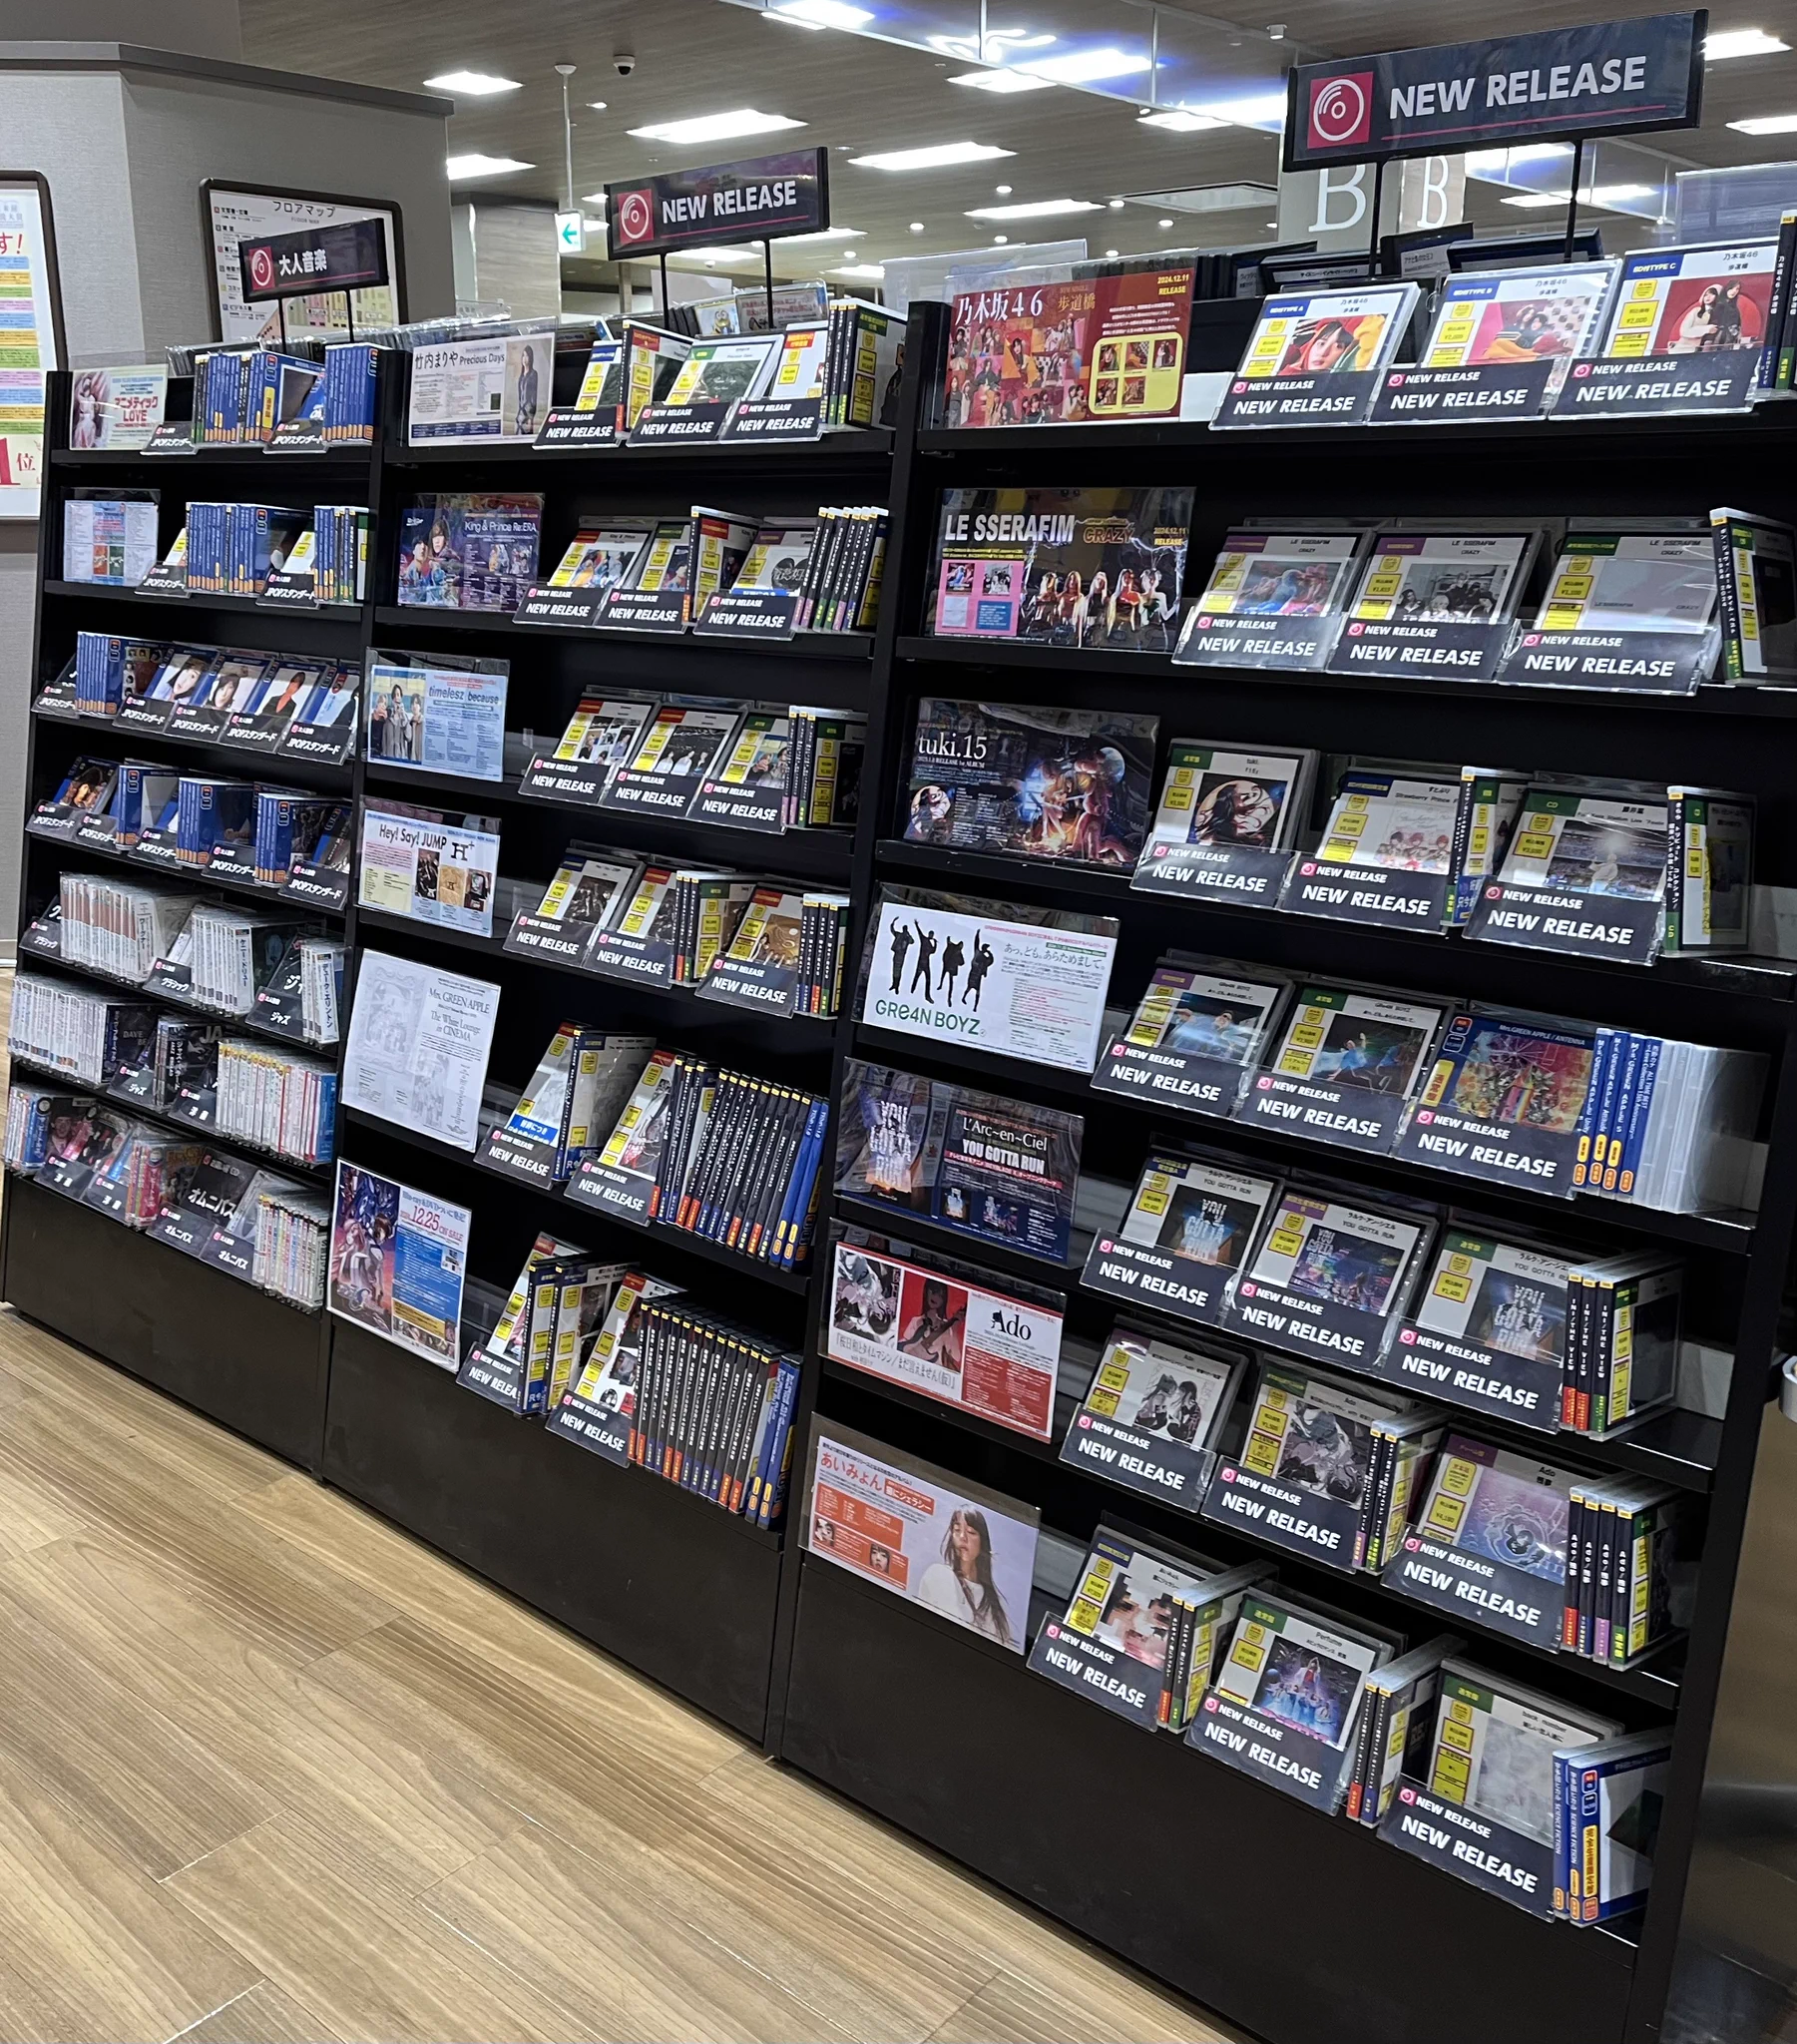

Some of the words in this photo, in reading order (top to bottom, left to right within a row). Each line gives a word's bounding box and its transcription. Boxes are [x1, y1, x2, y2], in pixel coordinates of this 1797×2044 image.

[1390, 78, 1474, 121] NEW
[1486, 55, 1647, 109] RELEASE
[272, 201, 336, 219] フロアマップ
[662, 195, 707, 225] NEW
[713, 180, 797, 217] RELEASE
[278, 249, 327, 276] 大人音楽
[1156, 273, 1190, 284] 2024.12.11
[1158, 284, 1187, 295] RELEASE
[1058, 292, 1096, 312] 歩道橋
[414, 351, 459, 370] 竹内まりや
[459, 354, 488, 365] Precious
[489, 352, 505, 364] Days
[1390, 394, 1439, 410] NEW
[1442, 387, 1527, 407] RELEASE
[1575, 383, 1632, 402] NEW
[1633, 379, 1732, 399] RELEASE
[123, 410, 148, 423] LOVE
[1233, 398, 1278, 415] NEW
[1279, 396, 1357, 413] RELEASE
[546, 427, 572, 439] NEW
[571, 426, 614, 438] RELEASE
[736, 419, 764, 432] NEW
[764, 416, 815, 430] RELEASE
[464, 520, 480, 534] King
[481, 520, 489, 531] &
[489, 520, 513, 532] Prince
[944, 514, 970, 542] LE
[974, 514, 1077, 543] SSERAFIM
[1083, 527, 1134, 545] CRAZY
[707, 611, 740, 627] NEW
[741, 612, 786, 628] RELEASE
[1198, 636, 1241, 653] NEW
[1245, 639, 1317, 657] RELEASE
[1350, 644, 1397, 661] NEW
[1399, 646, 1484, 667] RELEASE
[1524, 654, 1577, 671] NEW
[1581, 657, 1676, 677] RELEASE
[428, 685, 465, 701] timelesz
[467, 689, 500, 705] because
[918, 732, 988, 761] tuki.15
[701, 799, 729, 814] NEW
[729, 802, 778, 821] RELEASE
[378, 823, 399, 841] Hey!
[400, 827, 420, 845] Say!
[421, 832, 447, 849] JUMP
[1151, 864, 1194, 882] NEW
[1195, 869, 1268, 893] RELEASE
[1300, 884, 1349, 904] NEW
[1350, 889, 1431, 916] RELEASE
[1487, 909, 1540, 931] NEW
[1544, 916, 1634, 946] RELEASE
[160, 977, 190, 992] クラシック
[710, 976, 737, 992] NEW
[737, 980, 787, 1004] RELEASE
[442, 991, 468, 1008] GREEN
[467, 999, 491, 1014] APPLE
[269, 1011, 290, 1026] ジャズ
[460, 1019, 481, 1036] Lounge
[875, 998, 932, 1026] GRe4N
[934, 1011, 981, 1036] BOYZ
[443, 1025, 471, 1042] CINEMA
[1532, 1030, 1552, 1039] APPLE
[1556, 1034, 1585, 1046] ANTENNA
[128, 1083, 148, 1097] ジャズ
[1110, 1063, 1149, 1085] NEW
[1150, 1071, 1221, 1102] RELEASE
[1256, 1098, 1301, 1120] NEW
[1303, 1107, 1382, 1138] RELEASE
[963, 1138, 984, 1159] YOU
[985, 1145, 1019, 1167] GOTTA
[1021, 1154, 1046, 1176] RUN
[1417, 1132, 1469, 1159] NEW
[1470, 1142, 1558, 1178] RELEASE
[188, 1188, 236, 1220] オムニバス
[578, 1178, 603, 1197] NEW
[602, 1186, 646, 1212] RELEASE
[164, 1225, 194, 1245] オムニバス
[219, 1250, 249, 1271] オムニバス
[1099, 1261, 1138, 1285] NEW
[1141, 1274, 1209, 1307] RELEASE
[990, 1308, 1033, 1341] Ado
[1240, 1304, 1287, 1332] NEW
[1288, 1319, 1365, 1356] RELEASE
[469, 1366, 492, 1386] NEW
[490, 1375, 519, 1401] RELEA
[1401, 1353, 1453, 1382] NEW
[1453, 1368, 1540, 1410] RELEASE
[560, 1411, 584, 1431] NEW
[583, 1421, 627, 1453] RELEASE
[820, 1451, 883, 1492] あいみょん
[1078, 1436, 1115, 1463] NEW
[1118, 1451, 1186, 1491] RELEASE
[1538, 1466, 1557, 1477] Ado
[1221, 1491, 1264, 1520] NEW
[1266, 1508, 1341, 1551] RELEASE
[1403, 1560, 1454, 1591] NEW
[1454, 1579, 1542, 1628] RELEASE
[1316, 1631, 1343, 1647] Perfume
[1045, 1646, 1082, 1676] NEW
[1082, 1664, 1146, 1710] RELEASE
[1203, 1722, 1248, 1753] NEW
[1248, 1740, 1323, 1789] RELEASE
[1401, 1813, 1452, 1850] NEW
[1452, 1838, 1539, 1894] RELEASE
